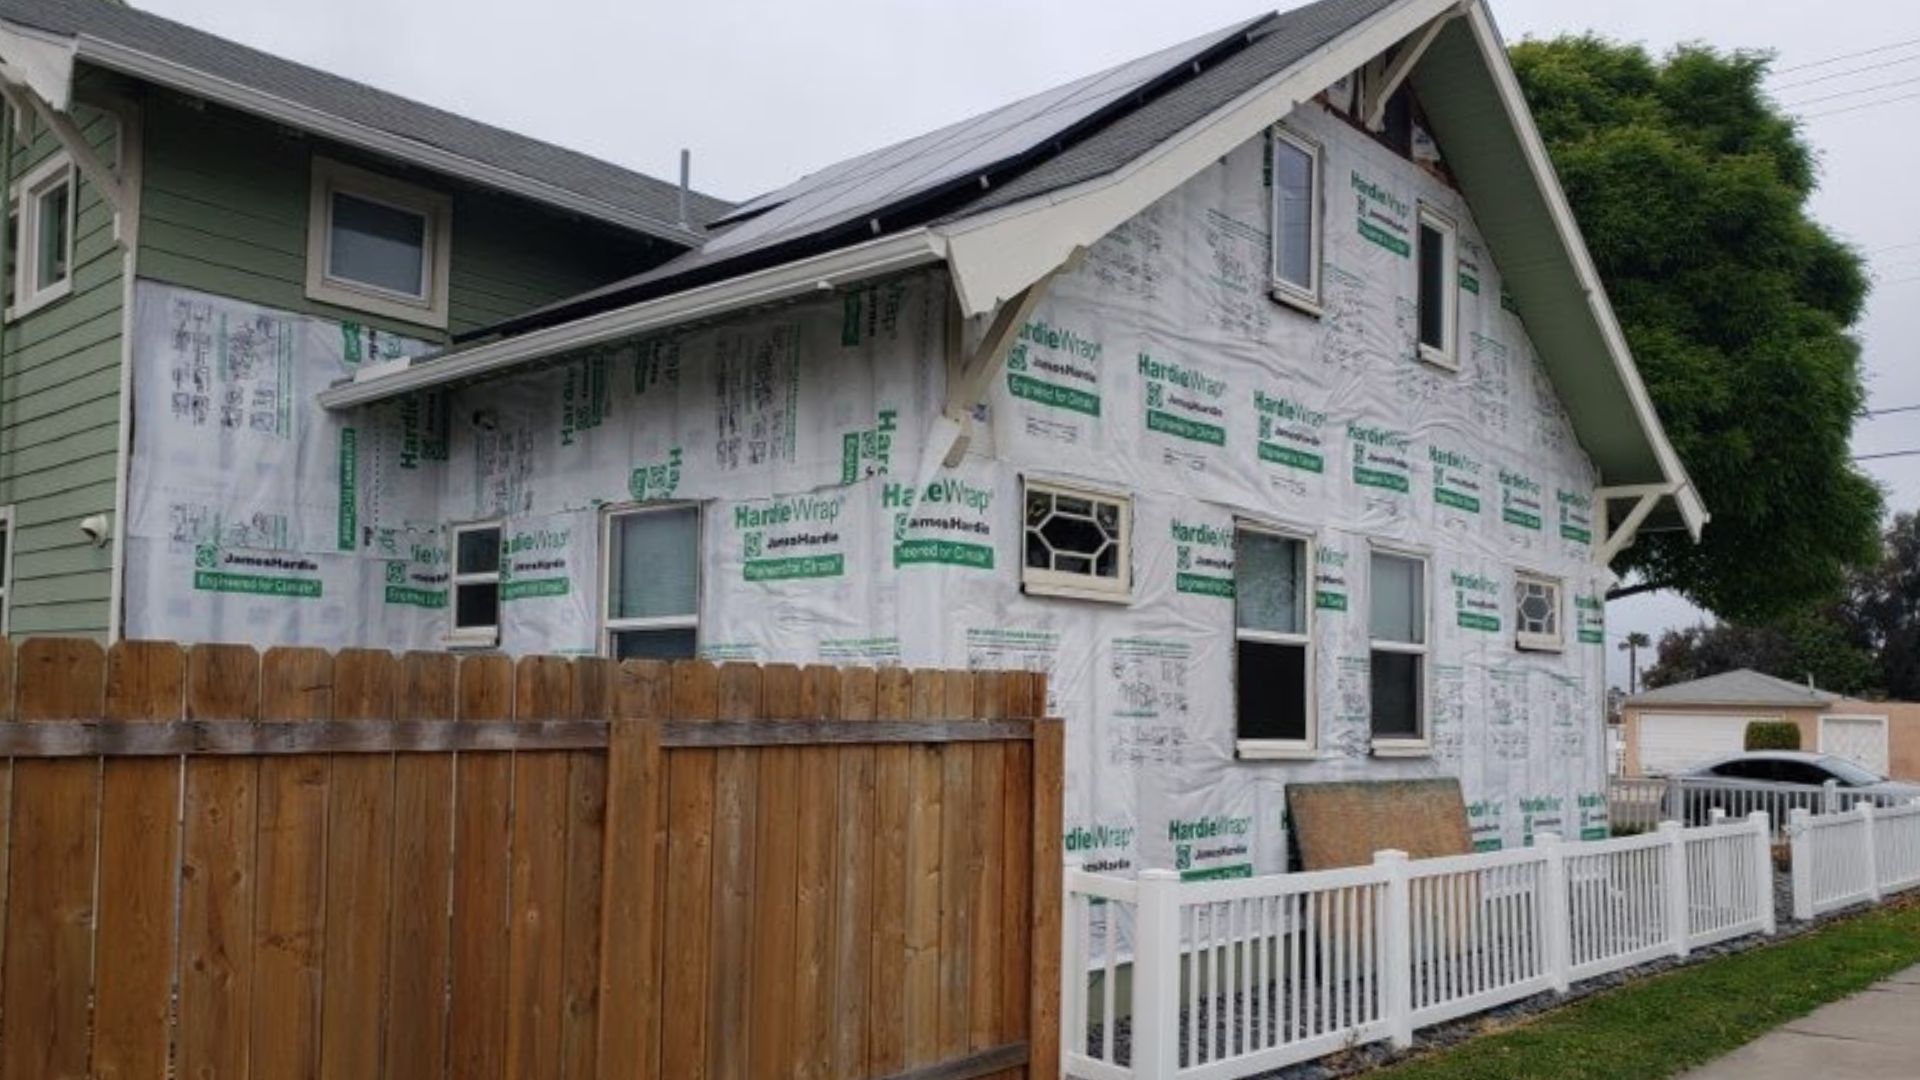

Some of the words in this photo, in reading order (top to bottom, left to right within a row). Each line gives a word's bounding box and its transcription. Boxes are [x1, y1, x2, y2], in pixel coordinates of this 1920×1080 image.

[734, 497, 838, 528] HardieWrap
[224, 553, 318, 571] JamesHardie
[1168, 815, 1248, 842] HardieWrap
